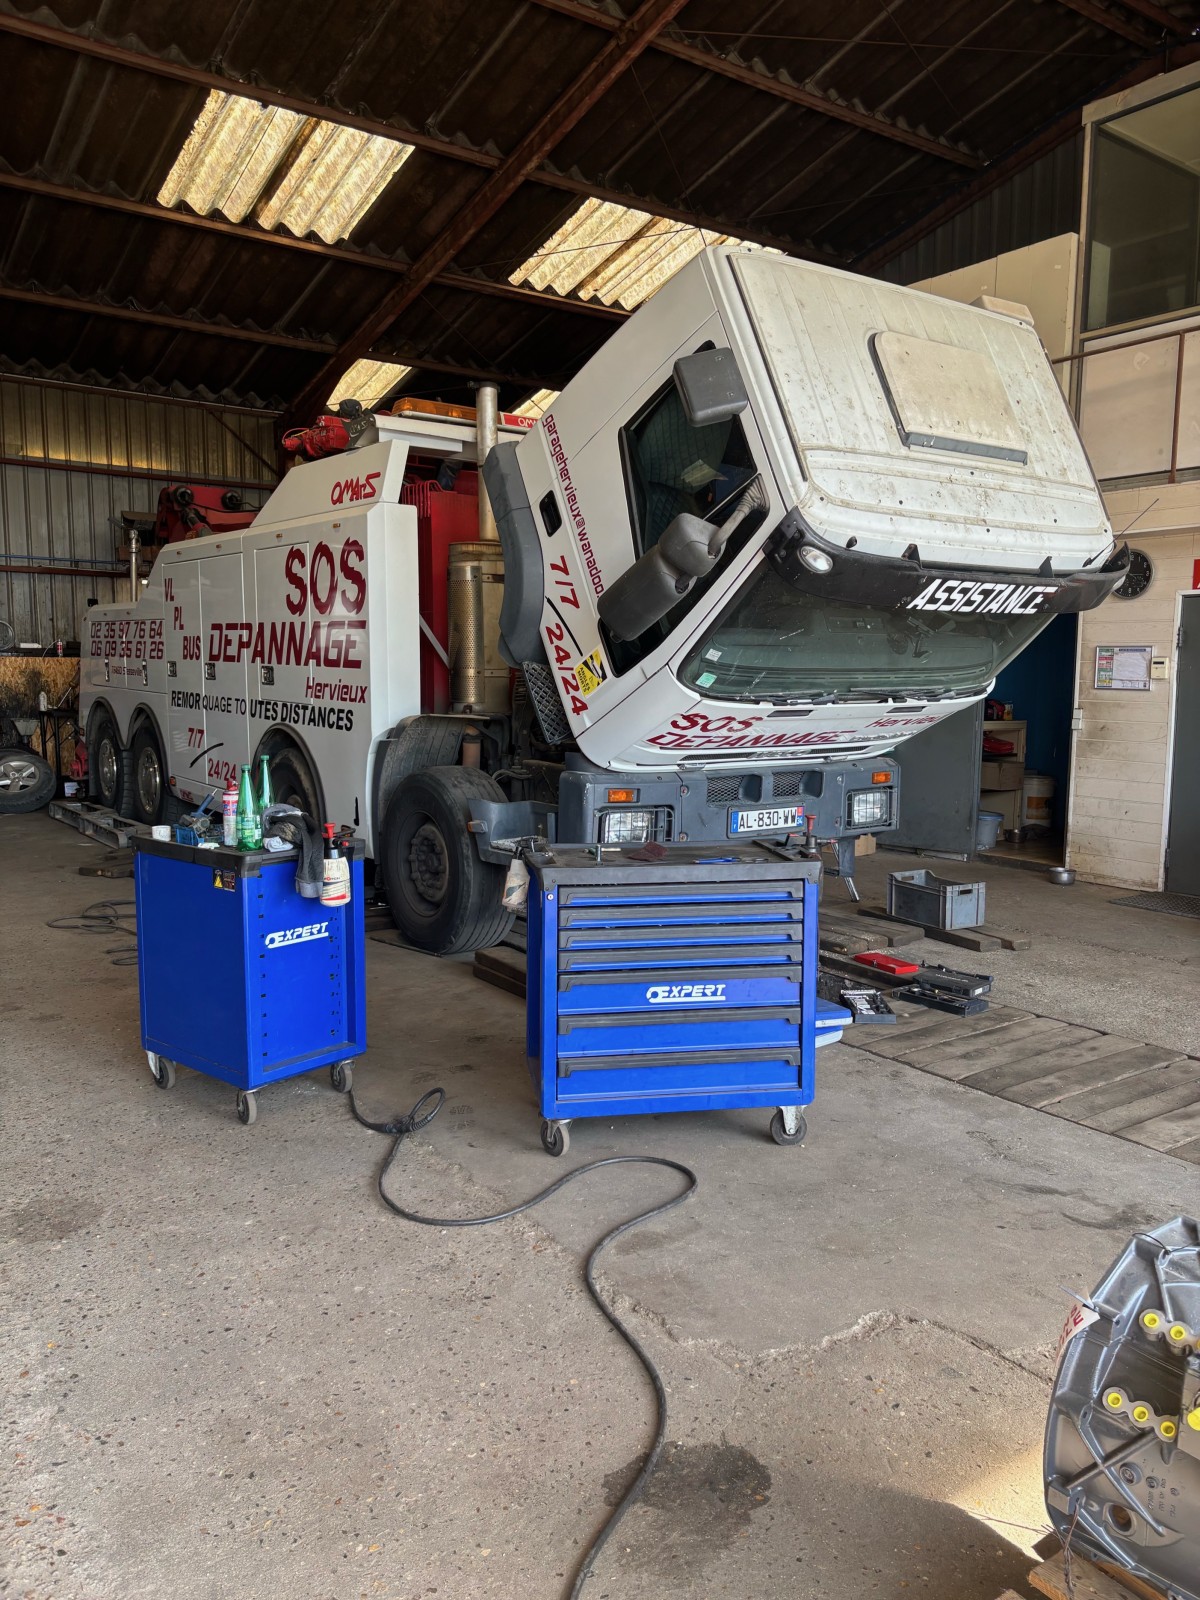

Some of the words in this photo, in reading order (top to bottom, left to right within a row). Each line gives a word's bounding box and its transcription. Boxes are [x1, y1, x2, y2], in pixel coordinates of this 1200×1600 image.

[285, 537, 366, 616] SOS
[164, 578, 174, 602] VL
[906, 579, 1059, 614] ASSISTANCE
[91, 622, 102, 639] 02
[104, 622, 116, 639] 35
[133, 621, 146, 639] 76
[149, 620, 163, 639] 64
[174, 606, 184, 630] PL
[91, 640, 102, 656] 06
[105, 640, 117, 657] 09
[120, 641, 133, 658] 35
[135, 641, 147, 659] 61
[149, 641, 164, 660] 26
[183, 635, 201, 660] BUS
[209, 620, 366, 669] DEPANNAGE
[305, 677, 368, 703] Hervieux
[280, 702, 354, 732] DISTANCES
[670, 713, 763, 732] SOS
[188, 728, 204, 748] 7/7
[646, 731, 858, 747] DEPANNAGE
[208, 758, 236, 782] 24/24
